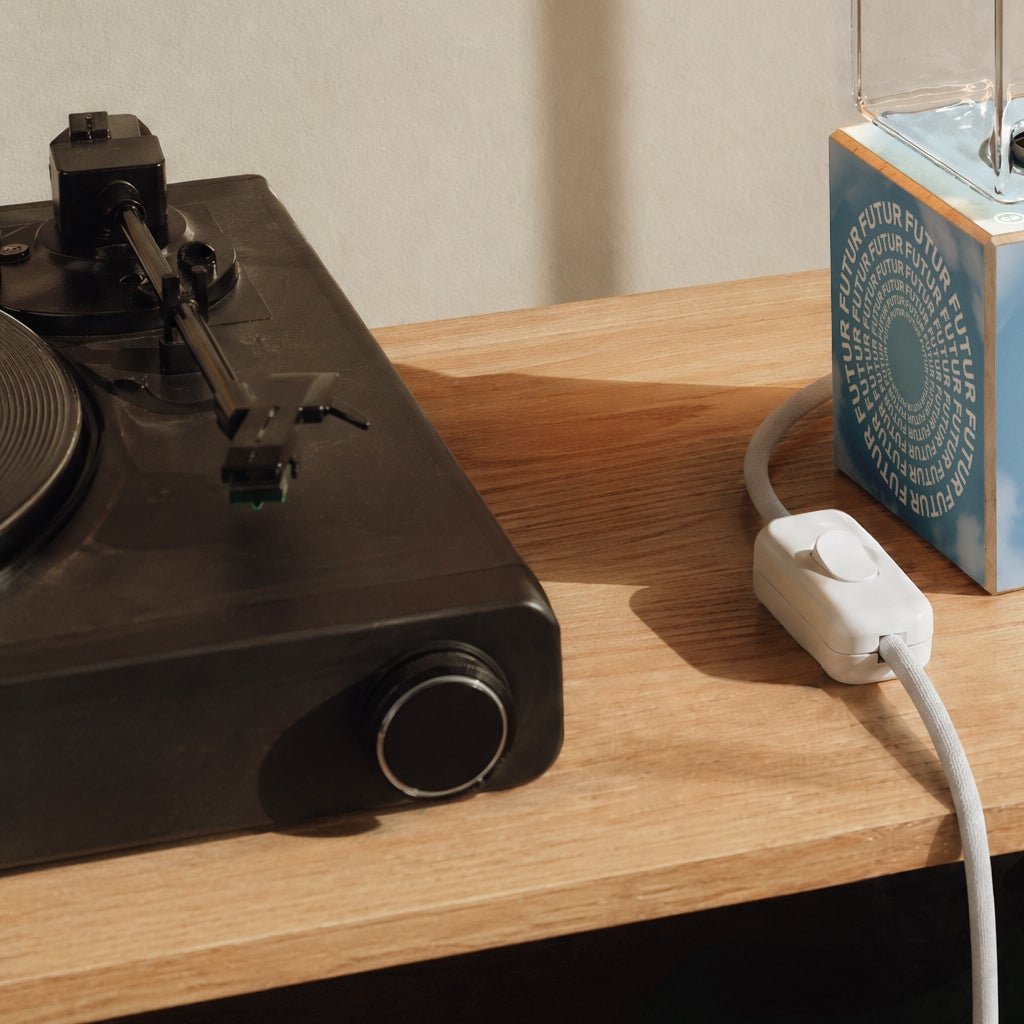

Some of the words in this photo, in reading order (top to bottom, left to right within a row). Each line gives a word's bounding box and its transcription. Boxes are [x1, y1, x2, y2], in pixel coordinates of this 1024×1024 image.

[858, 201, 901, 240] FUTUR
[867, 233, 902, 265] FUTUR
[905, 208, 952, 291] FUTUR
[839, 223, 863, 317] FUTUR
[852, 250, 872, 326] FUTUR
[863, 272, 878, 333] FUTUR
[875, 259, 903, 284] FUTUR
[905, 239, 942, 306] FUTUR
[905, 263, 935, 317] FUTUR
[839, 316, 866, 427] FUTUR
[852, 325, 874, 414] FUTUR
[863, 332, 880, 404] FUTUR
[932, 315, 950, 390] FUTUR
[939, 303, 961, 397] FUTUR
[948, 289, 976, 406] FUTUR
[870, 411, 906, 478] FUTUR
[877, 401, 906, 455] FUTUR
[908, 437, 937, 461] FUTUR
[933, 389, 950, 449] FUTUR
[940, 397, 962, 471] FUTUR
[949, 406, 976, 499] FUTUR
[861, 423, 906, 507] FUTUR
[909, 457, 945, 486] FUTUR
[910, 481, 955, 517] FUTUR
